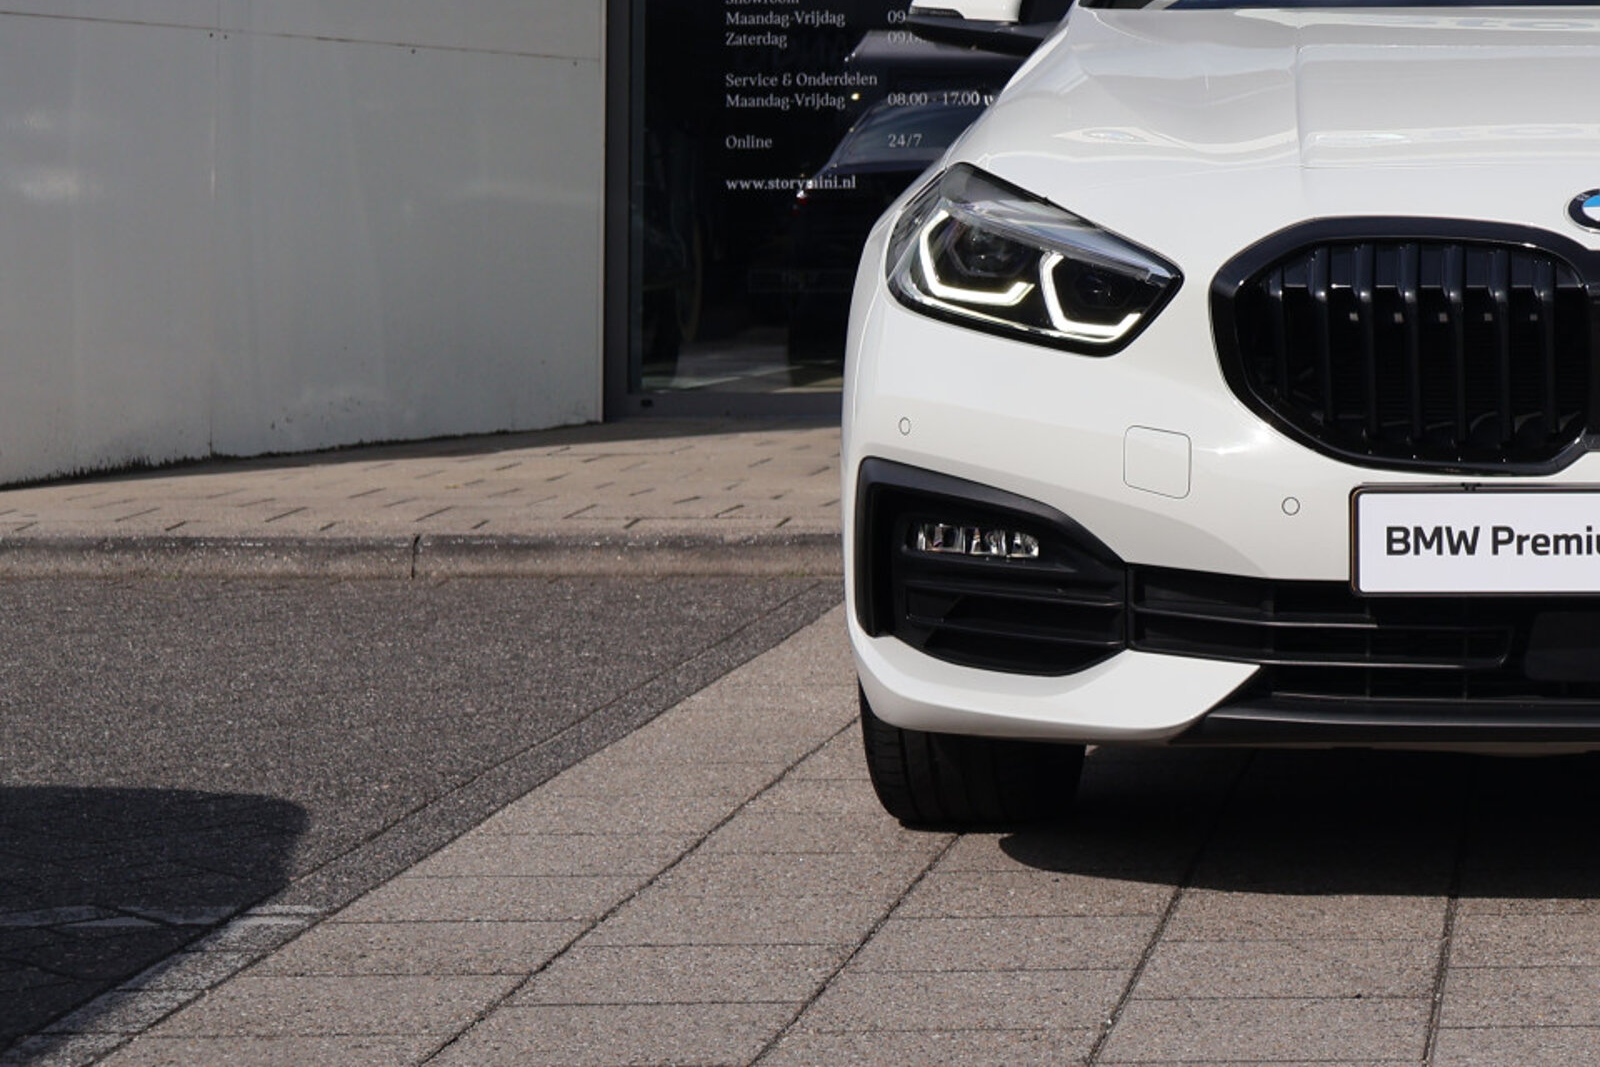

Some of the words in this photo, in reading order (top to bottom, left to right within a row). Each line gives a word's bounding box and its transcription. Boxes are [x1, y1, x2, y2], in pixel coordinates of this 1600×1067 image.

[726, 11, 846, 27] Maandag-Vrijdag
[726, 32, 787, 48] Zaterdag
[726, 74, 777, 86] Service
[783, 73, 791, 85] &
[796, 72, 878, 86] Onderdelen
[726, 93, 846, 109] Maandag-Vrijdag
[887, 92, 928, 106] 08.00
[942, 91, 980, 105] 17.00
[726, 135, 772, 148] Online
[888, 134, 922, 147] 24/7
[1386, 526, 1480, 555] BMW
